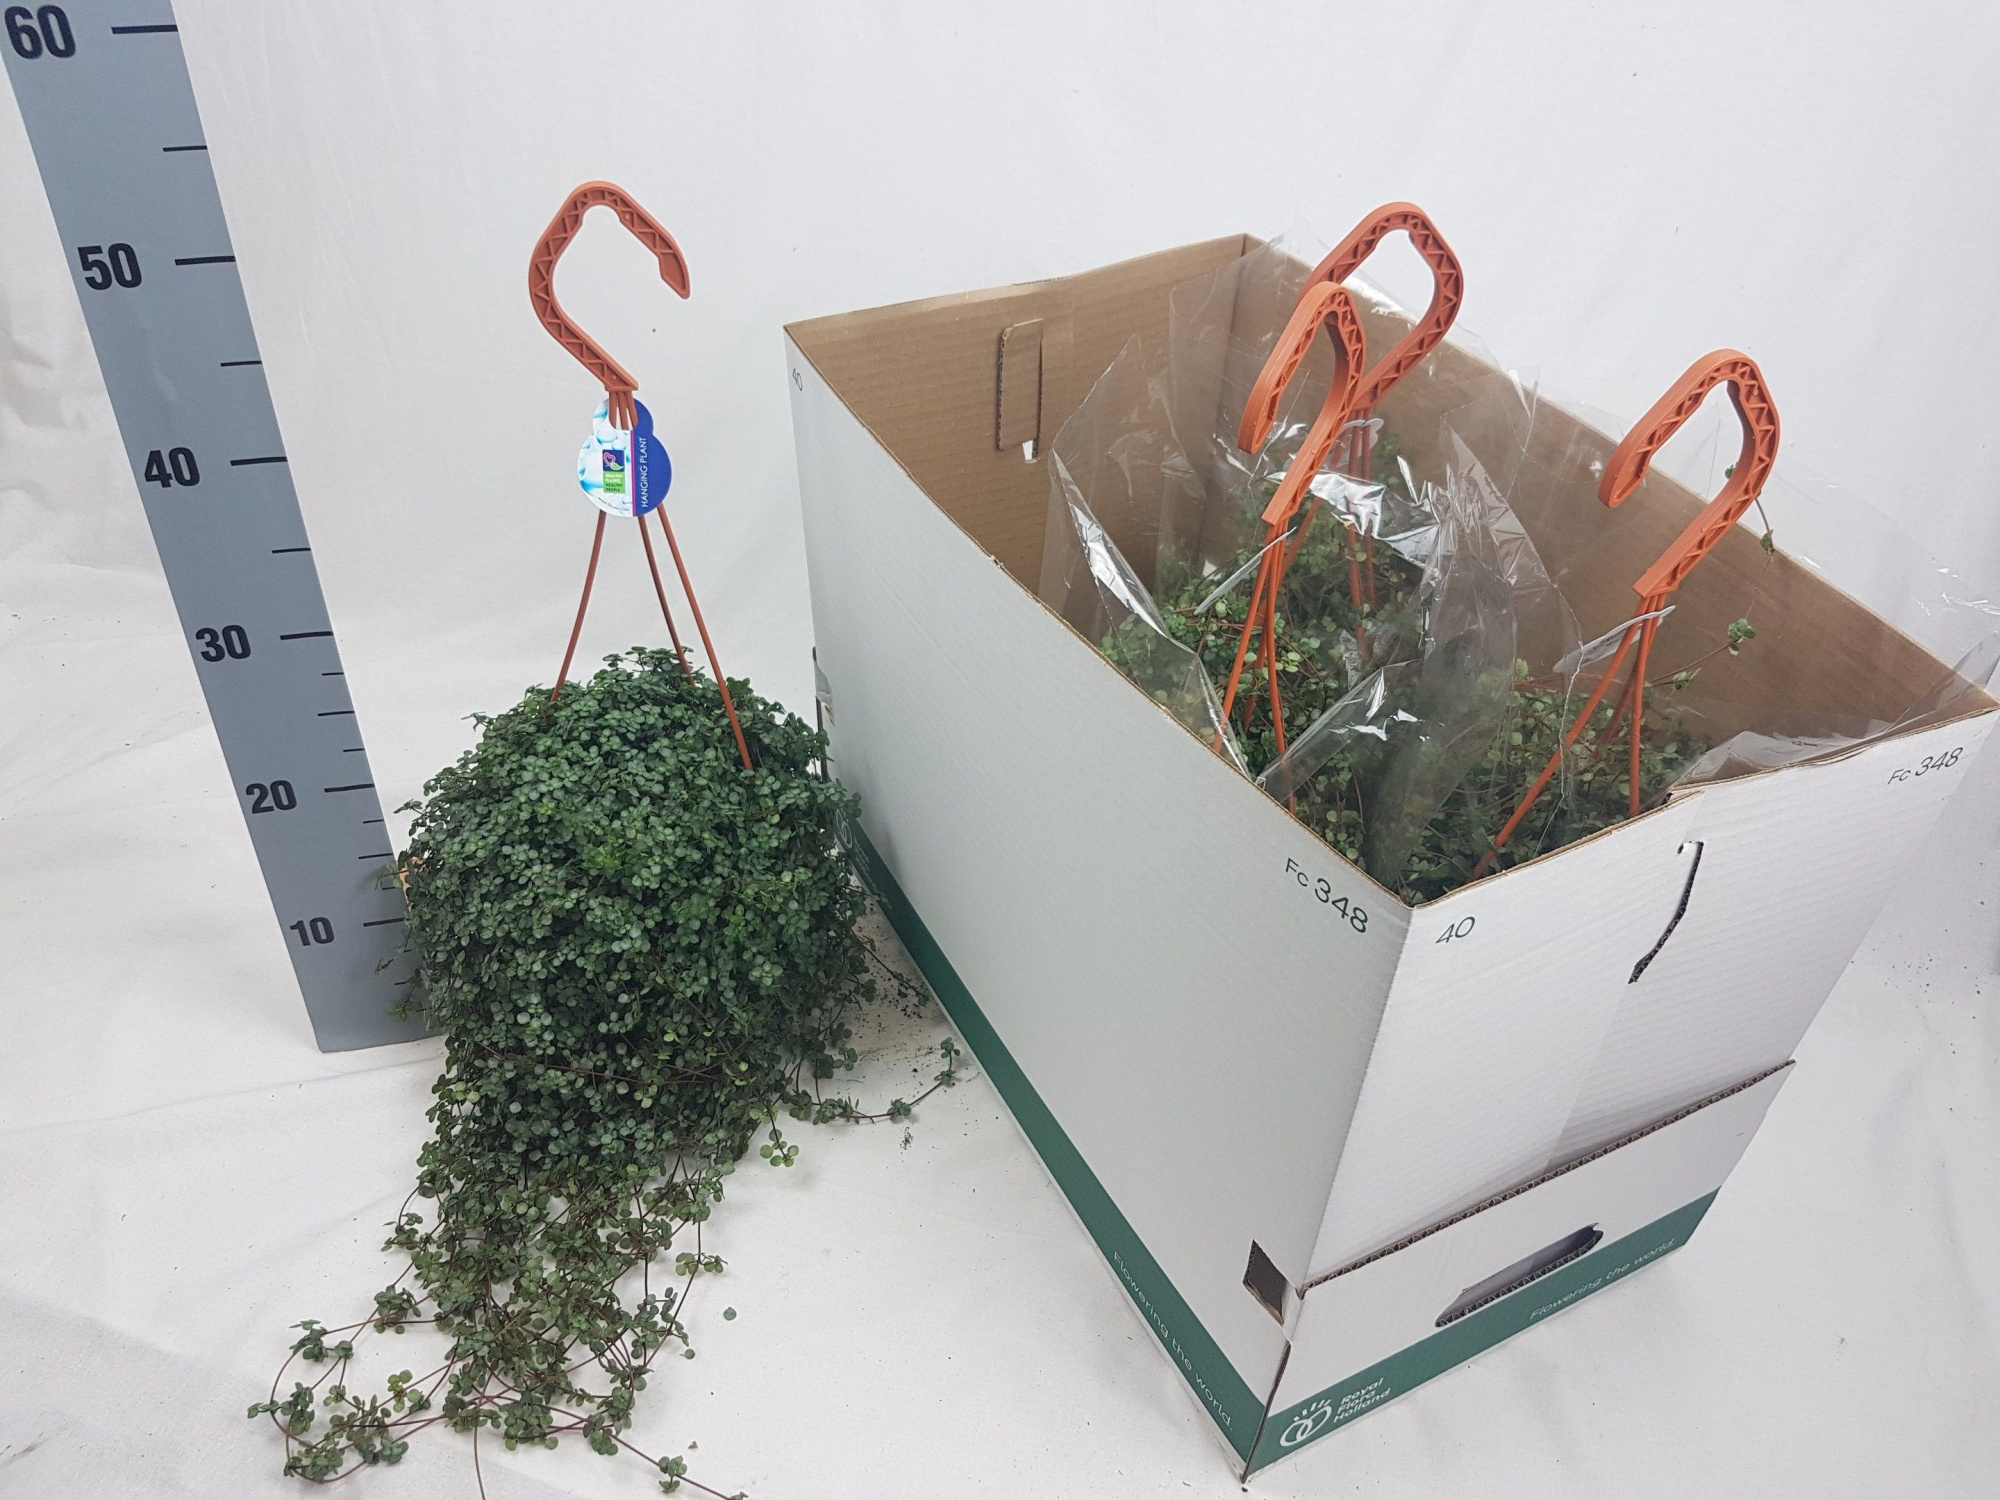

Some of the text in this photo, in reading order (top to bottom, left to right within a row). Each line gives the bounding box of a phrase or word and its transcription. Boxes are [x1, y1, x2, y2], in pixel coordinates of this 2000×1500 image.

[4, 5, 76, 60] 60
[77, 242, 143, 291] 50
[792, 368, 803, 391] 40
[144, 447, 201, 488] 40
[640, 437, 648, 508] HANGING PLANT
[195, 624, 252, 663] 30
[1915, 746, 1964, 777] 348
[245, 779, 298, 814] 20
[1314, 877, 1369, 934] 348
[289, 916, 336, 947] 10
[1434, 915, 1476, 945] 40
[1529, 1277, 1602, 1320] Flowering
[1605, 1262, 1631, 1280] the
[1113, 1251, 1170, 1339] Flowering
[1172, 1337, 1193, 1371] the
[1332, 1387, 1392, 1424] Holland
[1336, 1390, 1376, 1415] Flora
[1340, 1376, 1385, 1406] Royal
